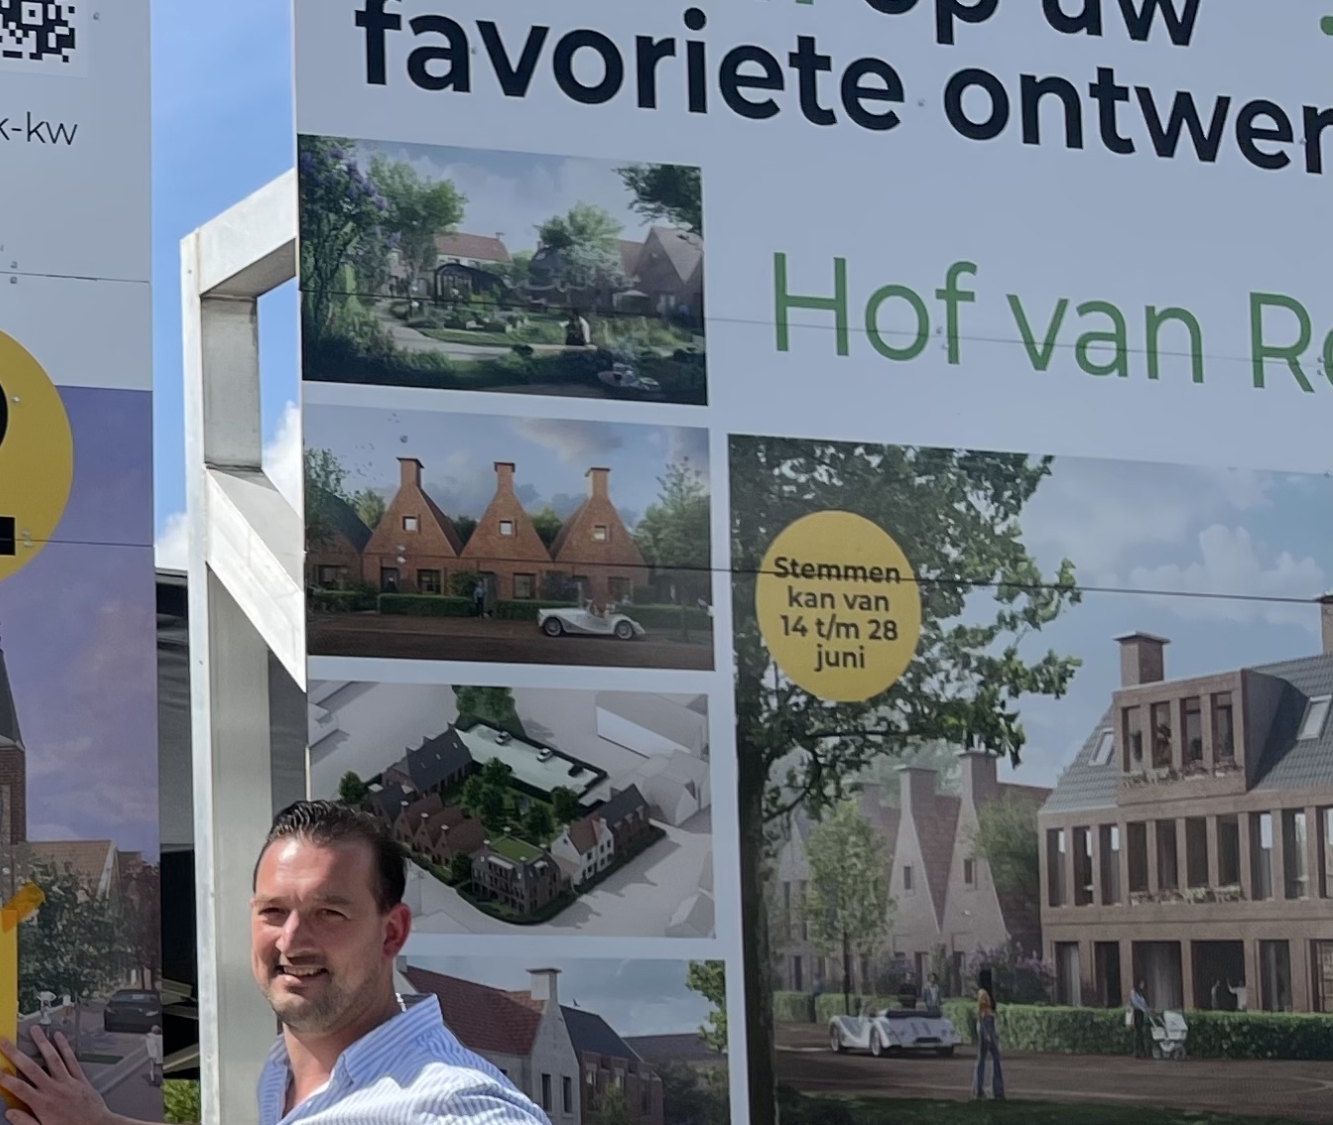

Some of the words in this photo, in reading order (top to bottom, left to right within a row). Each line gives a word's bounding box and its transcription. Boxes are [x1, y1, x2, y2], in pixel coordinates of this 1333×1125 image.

[355, 0, 904, 131] favoriete
[774, 252, 977, 365] Hof
[1006, 293, 1204, 383] van
[1250, 291, 1333, 393] R
[774, 557, 900, 584] Stemmen
[788, 586, 835, 609] kan
[843, 593, 889, 612] van
[781, 615, 808, 637] 14
[815, 613, 859, 641] t/m
[867, 619, 898, 641] 28
[814, 644, 865, 672] juni
